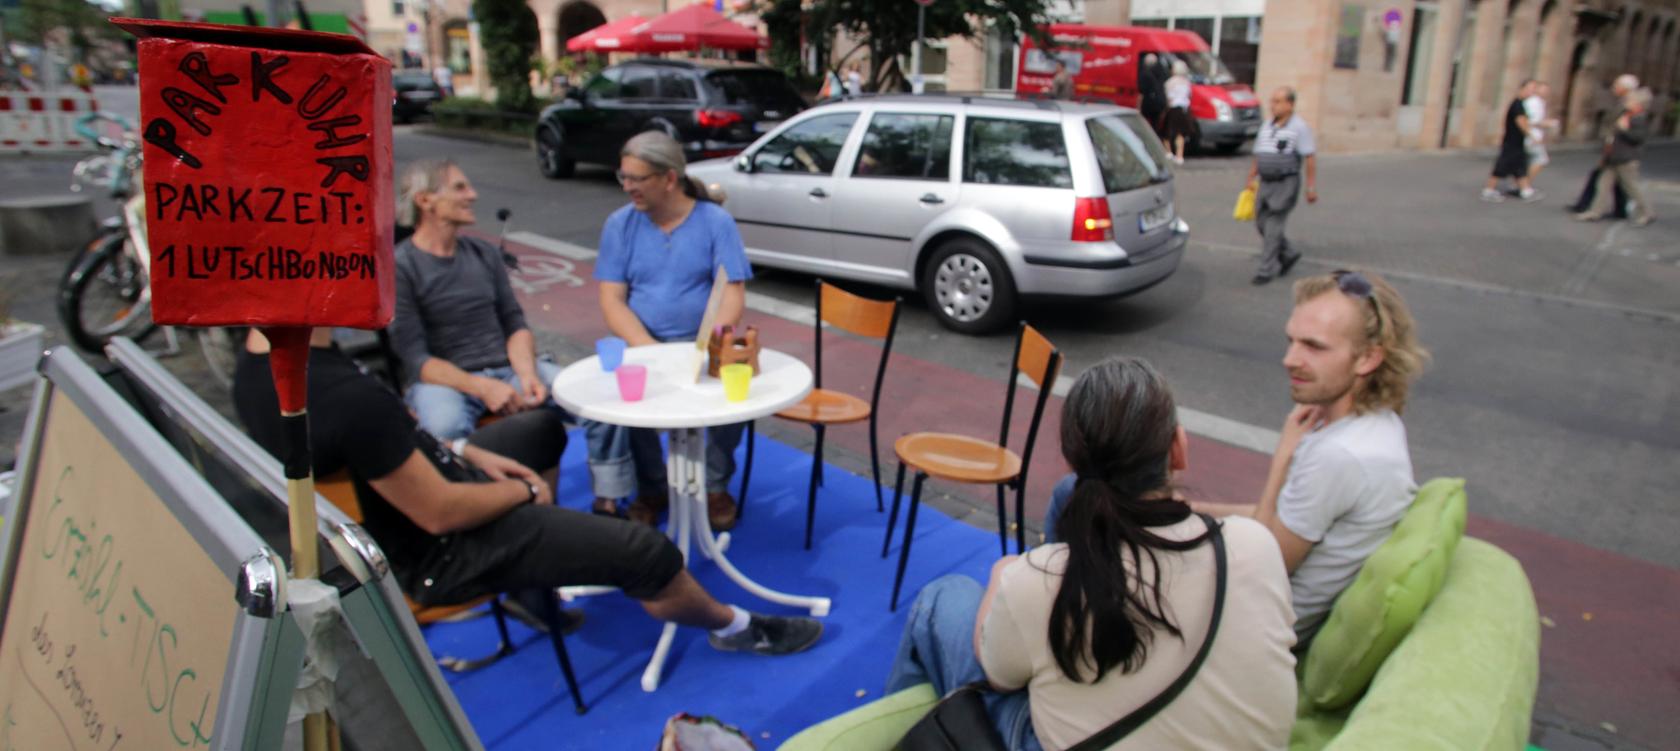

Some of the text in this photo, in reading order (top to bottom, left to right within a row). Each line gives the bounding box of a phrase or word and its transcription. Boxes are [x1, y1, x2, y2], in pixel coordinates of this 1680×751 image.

[143, 51, 369, 188] PARKUHR
[155, 182, 365, 225] PARKZEIT:
[158, 244, 175, 278] 1
